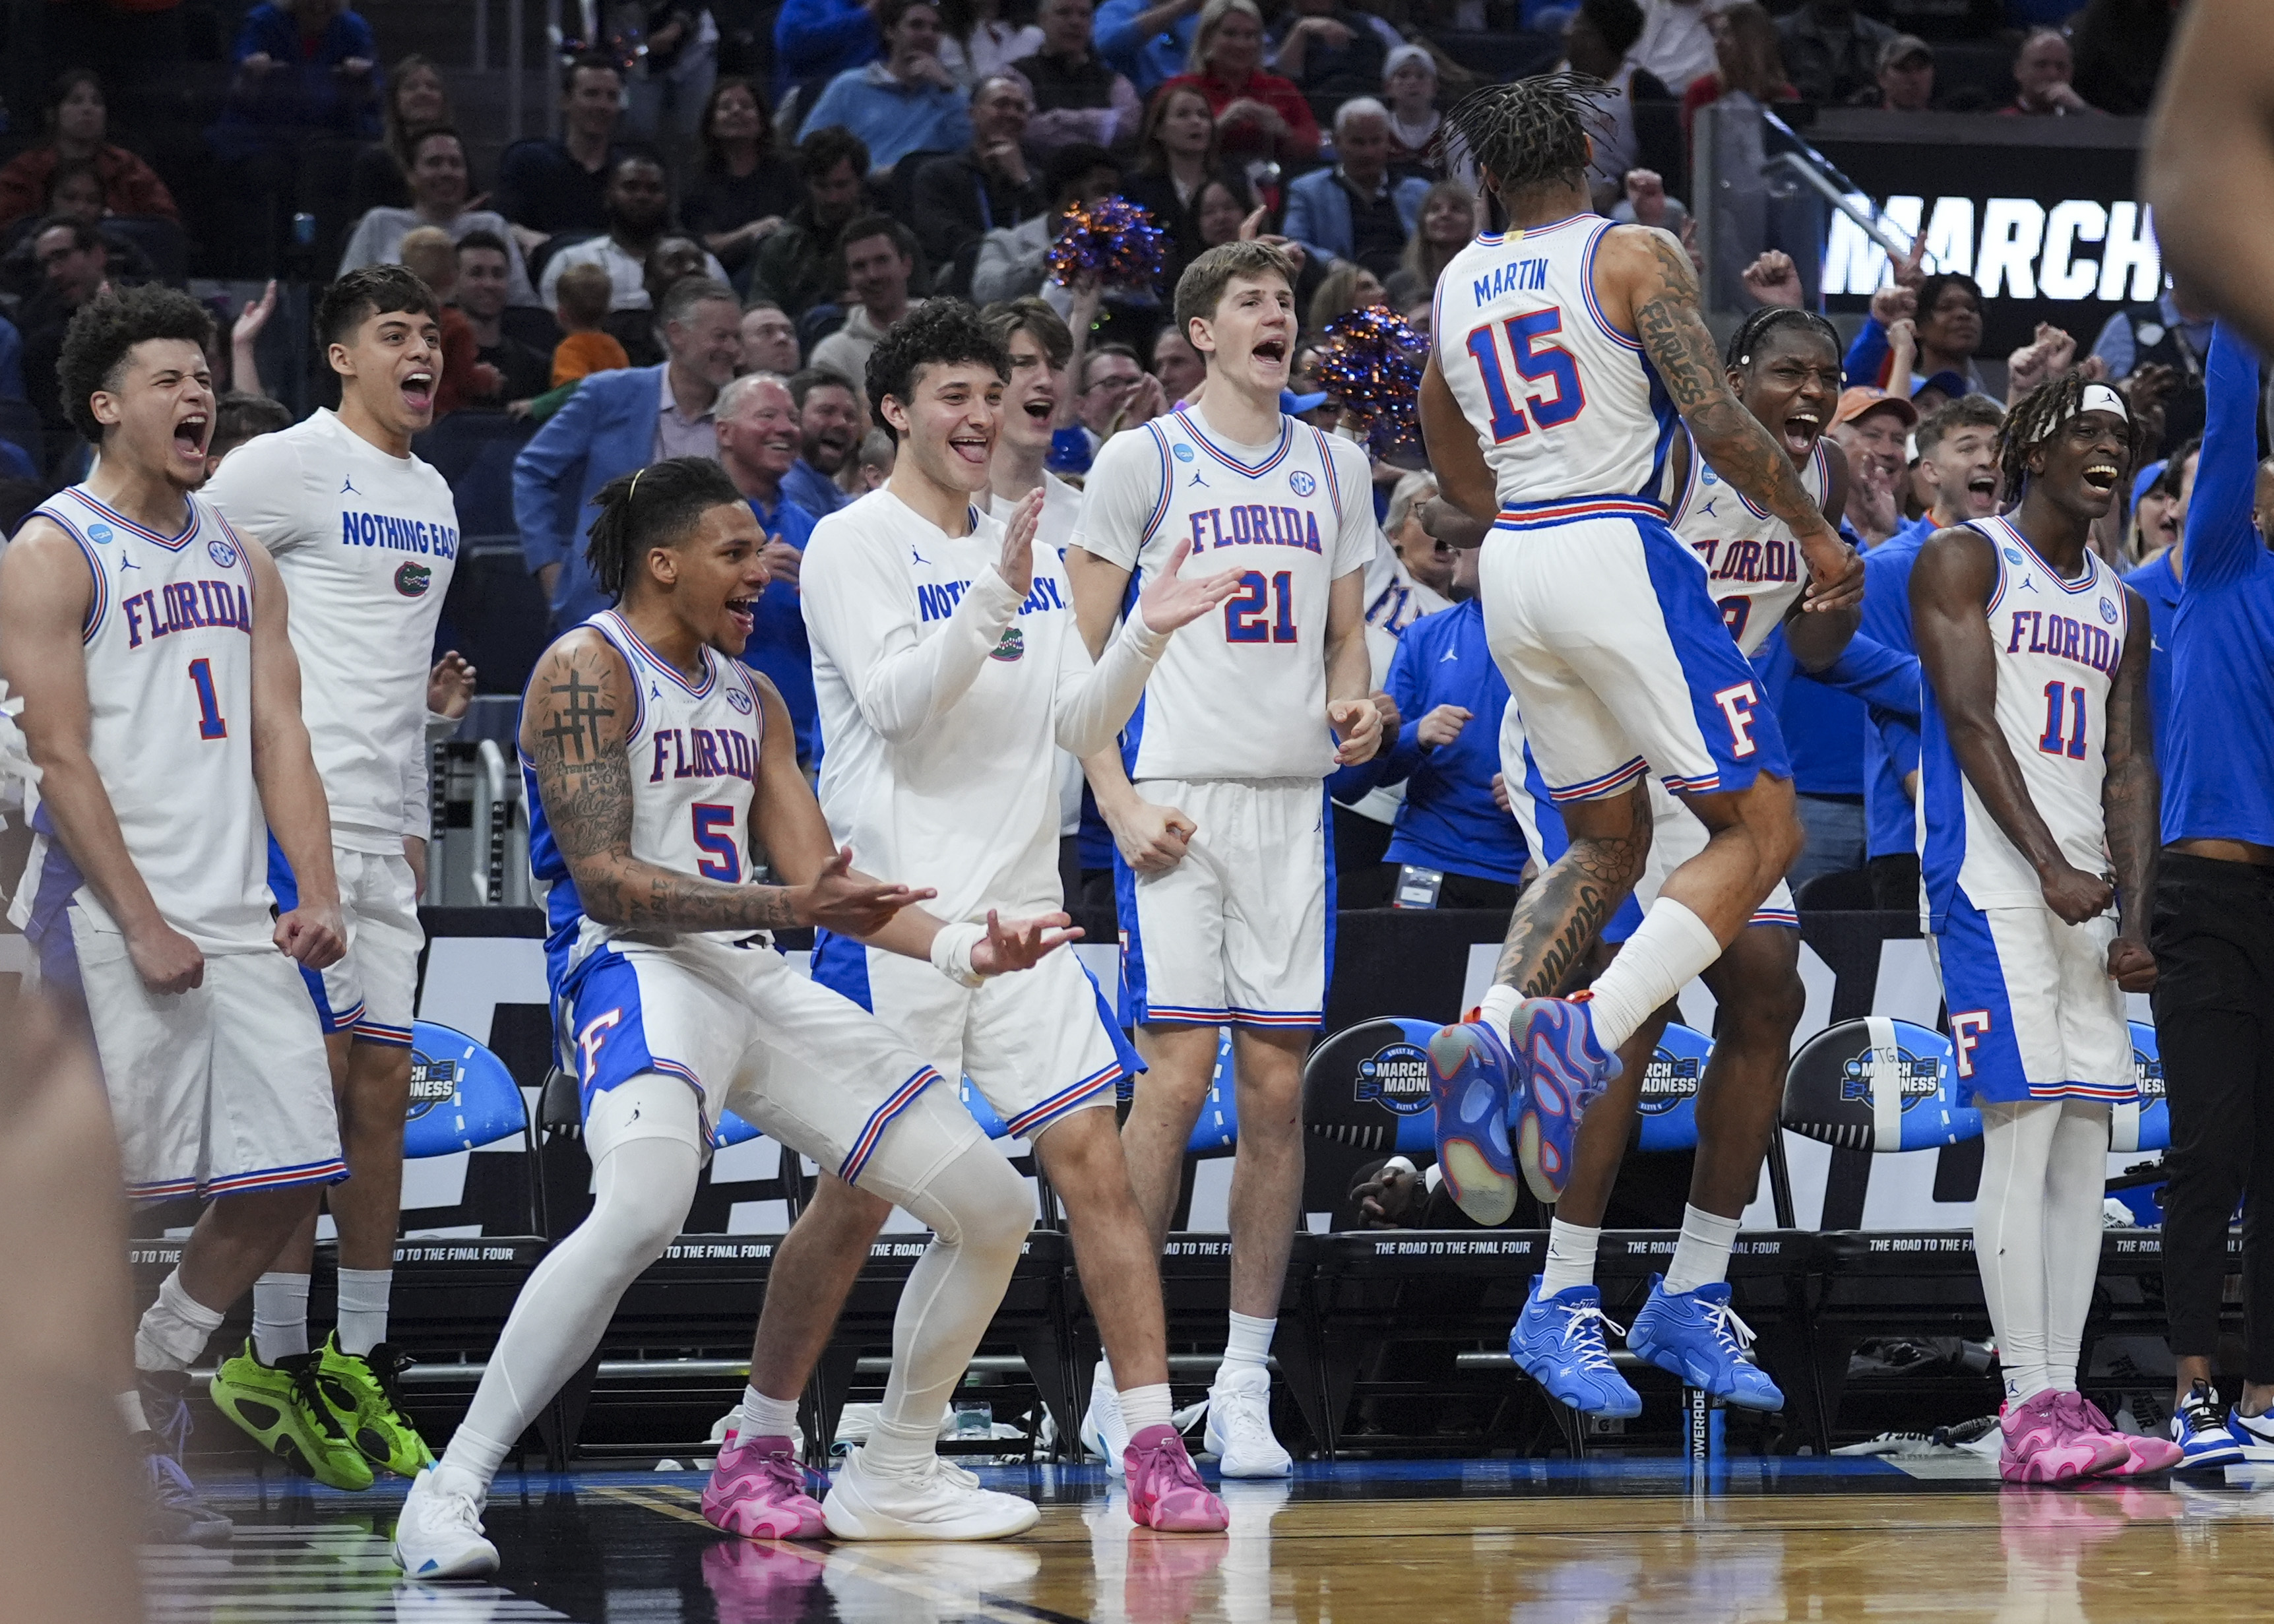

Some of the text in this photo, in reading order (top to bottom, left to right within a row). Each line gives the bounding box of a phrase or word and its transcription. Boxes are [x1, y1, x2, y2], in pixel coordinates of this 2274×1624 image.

[1821, 193, 2163, 301] MARCH
[1473, 259, 1549, 307] MARTIN
[1466, 306, 1586, 445] 15
[1637, 300, 1707, 405] FEARLESS
[1291, 472, 1315, 495] SEC
[342, 511, 429, 553] NOTHING
[1189, 505, 1322, 555] FLORIDA
[122, 580, 251, 649] FLORIDA
[1224, 570, 1298, 643] 21
[188, 658, 228, 740] 1
[1713, 680, 1759, 759] F
[2038, 680, 2087, 761] 11
[691, 802, 742, 884] 5
[580, 1007, 622, 1092] F
[1874, 1047, 1897, 1064] TG
[1950, 1009, 1992, 1080] F
[1376, 1062, 1428, 1077] MARCH
[141, 1250, 158, 1263] TO
[159, 1250, 181, 1263] THE
[406, 1248, 422, 1261] TO
[424, 1248, 446, 1261] THE
[447, 1247, 480, 1261] FINAL
[482, 1247, 514, 1261] FOUR
[666, 1245, 681, 1259] TO
[683, 1245, 705, 1258] THE
[706, 1245, 739, 1258] FINAL
[740, 1245, 772, 1258] FOUR
[870, 1243, 924, 1257] THE ROAD
[1182, 1243, 1197, 1255] TO
[1199, 1243, 1220, 1255] THE
[1375, 1241, 1531, 1254] THE ROAD TO THE FINAL FOUR
[1627, 1241, 1648, 1254] THE
[1650, 1241, 1679, 1254] ROAD
[1752, 1241, 1781, 1254] FOUR
[1870, 1239, 1891, 1251] THE
[1892, 1239, 1922, 1251] ROAD
[1923, 1239, 1938, 1251] TO
[1940, 1239, 1961, 1251] THE
[2116, 1240, 2162, 1252] THE ROA
[1693, 1390, 1705, 1460] OWERADE
